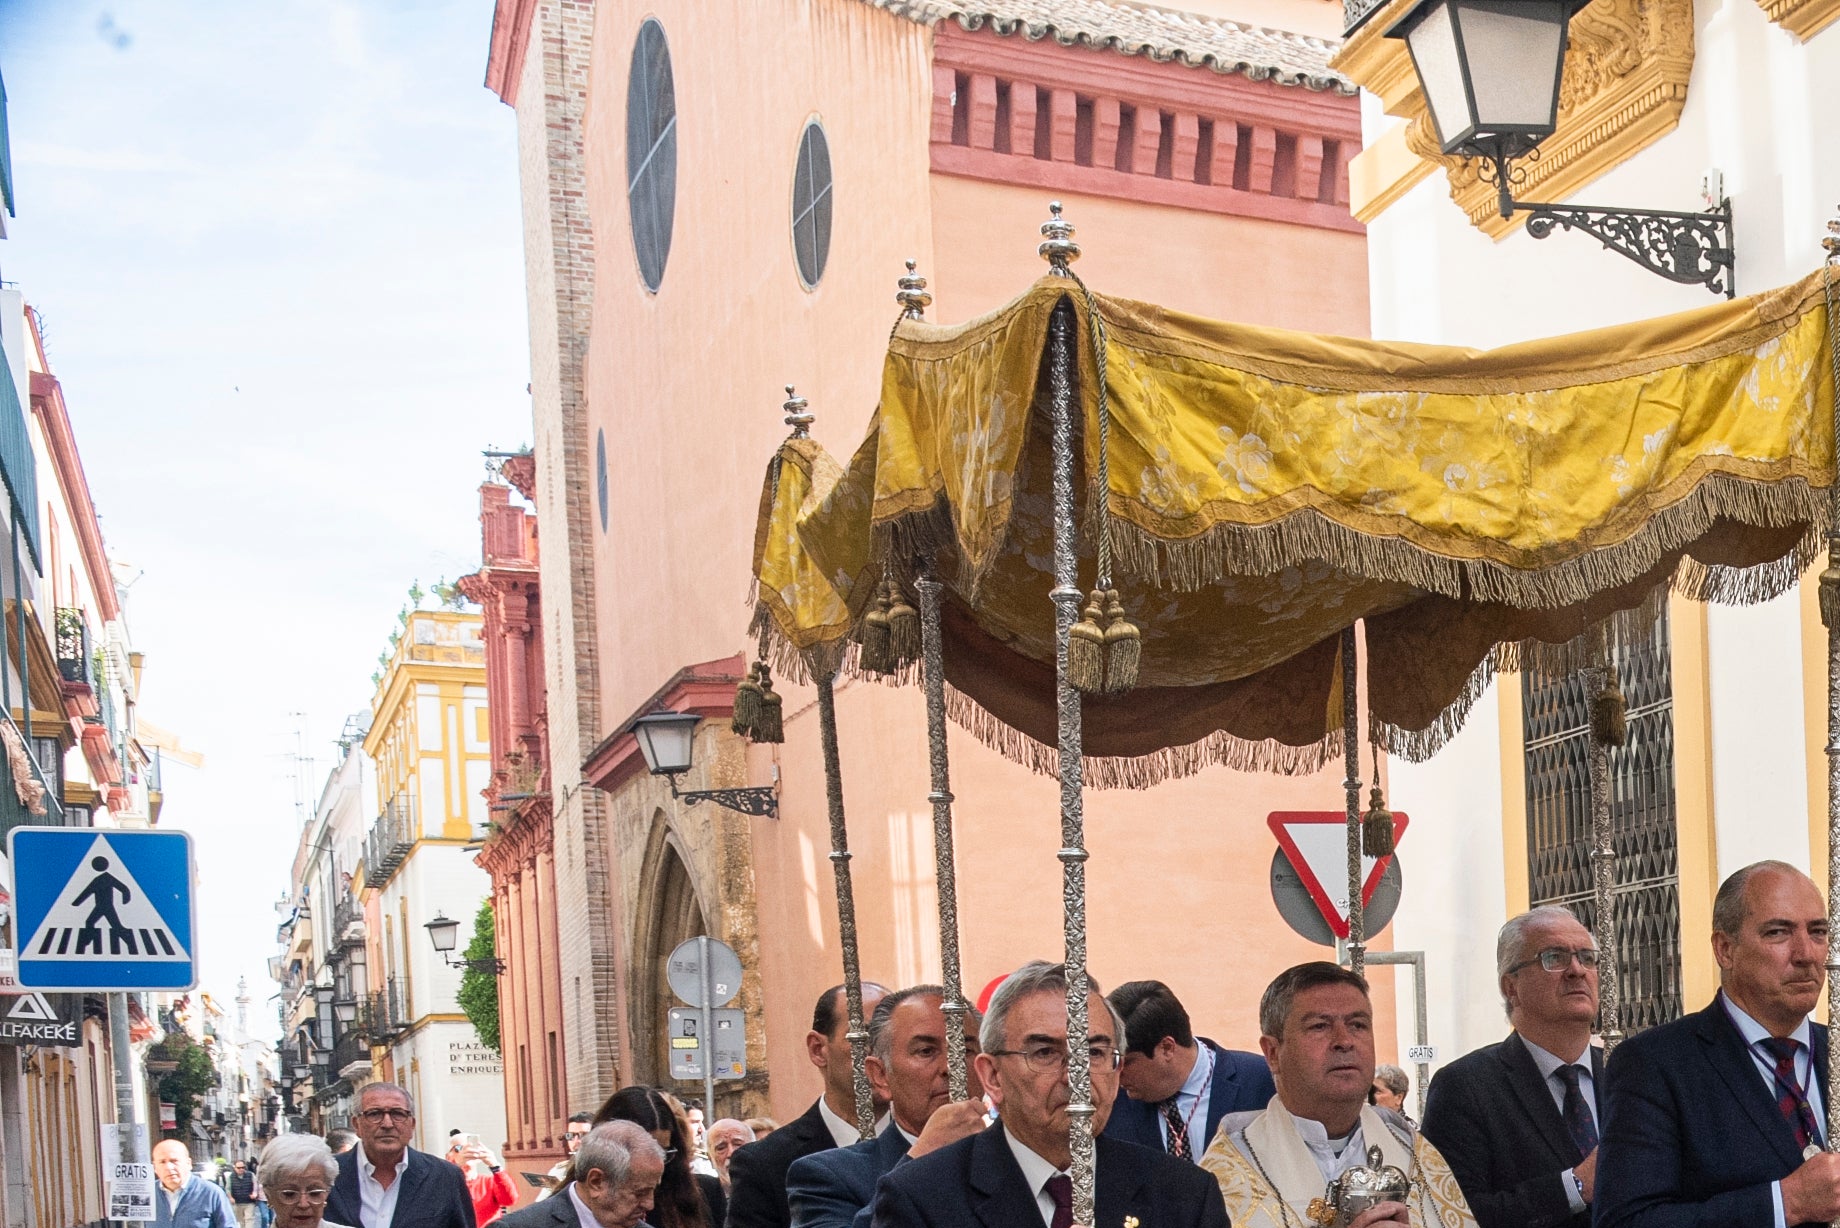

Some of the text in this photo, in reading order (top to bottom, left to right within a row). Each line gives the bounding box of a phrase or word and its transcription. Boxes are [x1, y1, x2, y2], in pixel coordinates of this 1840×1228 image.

[0, 1021, 76, 1041] LFAKEKÉ
[449, 1042, 489, 1050] PLAZA
[1408, 1047, 1434, 1058] GRATIS
[115, 1164, 148, 1179] GRATIS
